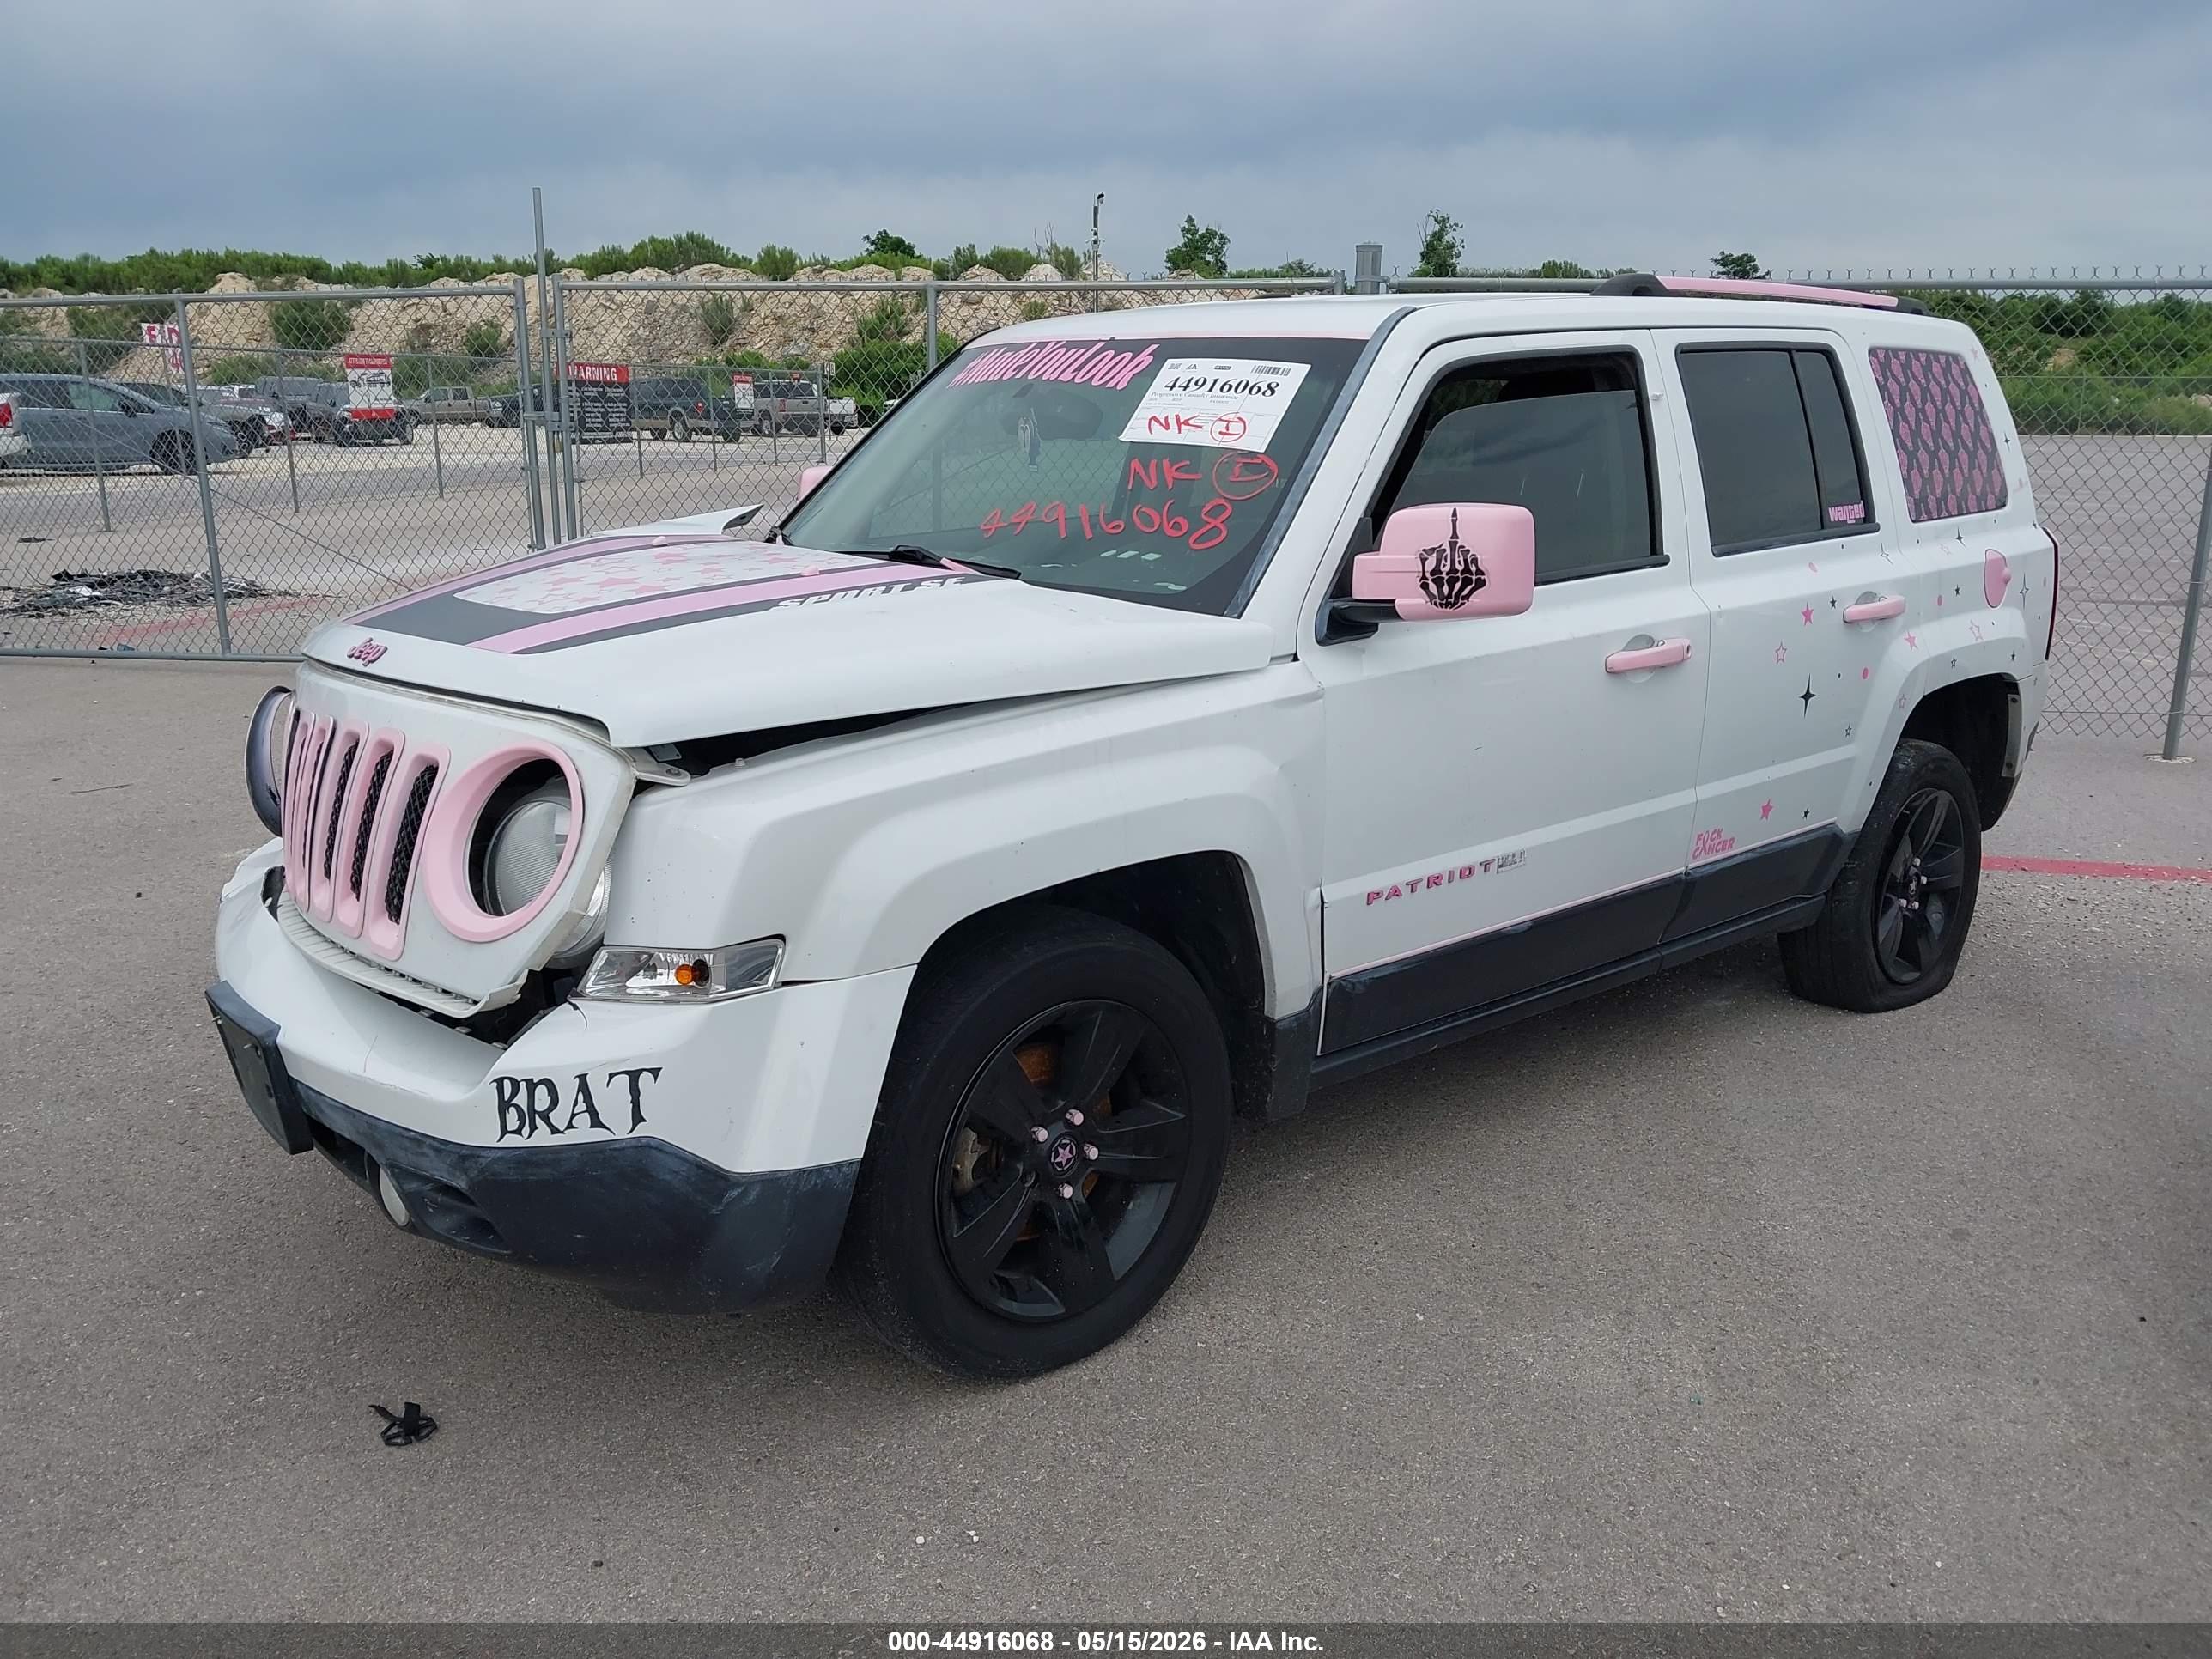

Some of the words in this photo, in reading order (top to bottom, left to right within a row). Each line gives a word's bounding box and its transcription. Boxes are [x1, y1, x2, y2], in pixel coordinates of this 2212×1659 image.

[568, 365, 617, 380] WARNING
[1164, 376, 1279, 398] 44916068
[1148, 413, 1202, 434] NK
[1127, 458, 1202, 490] NK
[980, 499, 1232, 550] 44916068
[346, 637, 388, 667] Jeep
[1366, 858, 1496, 906] PATRIOT
[489, 1067, 663, 1143] BRAT
